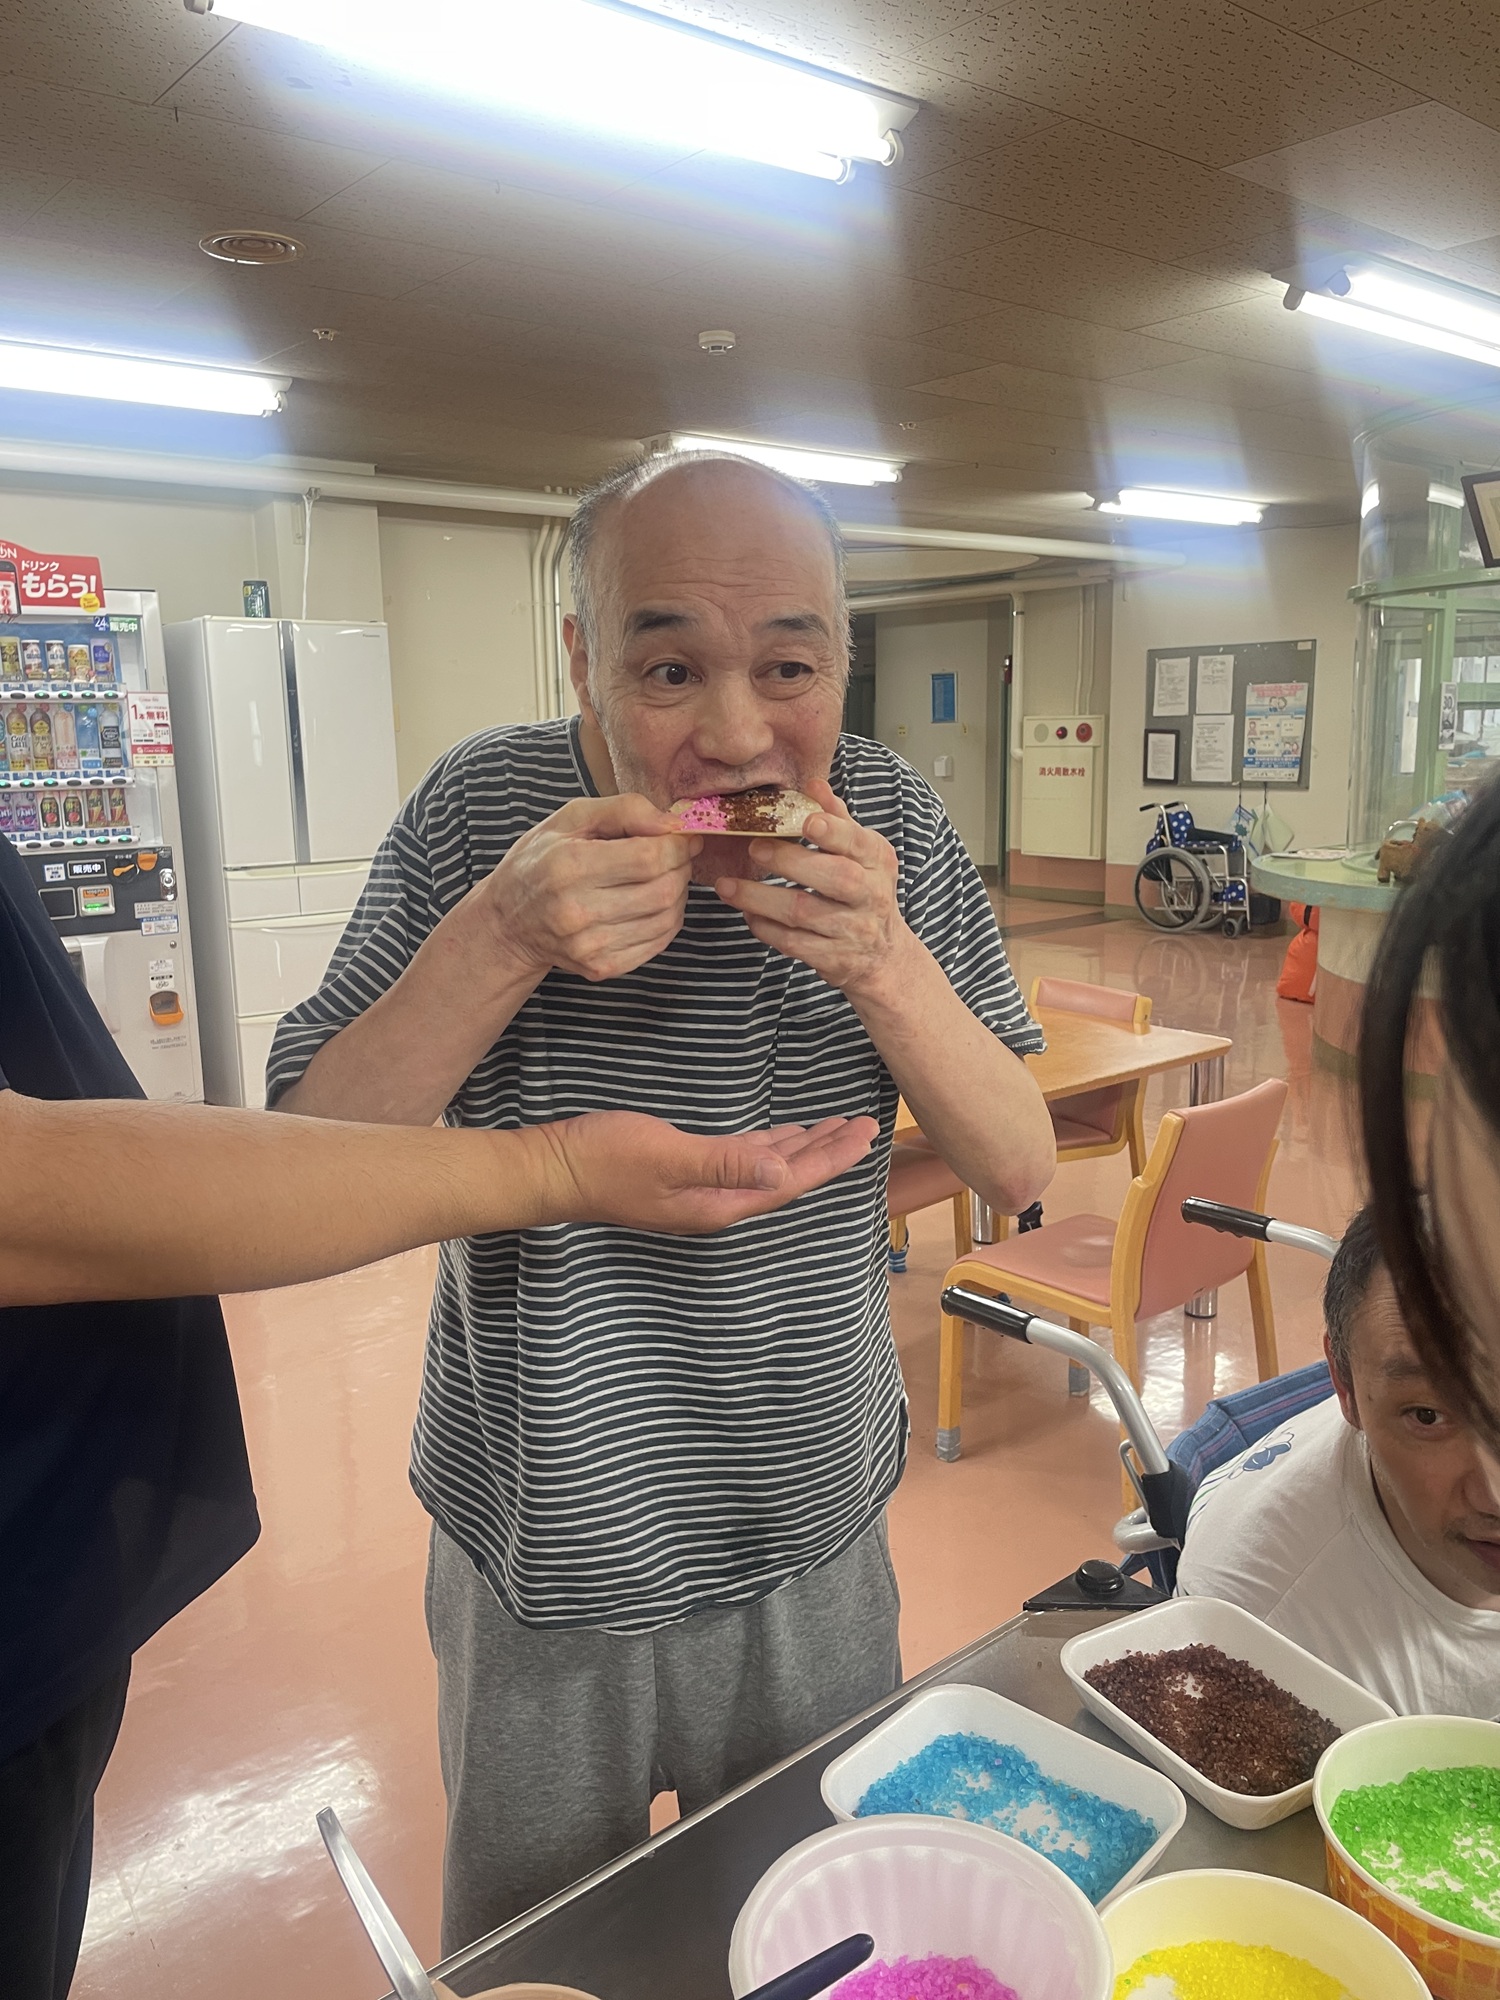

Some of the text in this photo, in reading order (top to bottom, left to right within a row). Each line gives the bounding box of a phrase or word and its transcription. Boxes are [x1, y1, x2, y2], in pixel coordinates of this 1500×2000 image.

[21, 560, 60, 572] ドリンク
[21, 572, 97, 600] もらう!
[109, 622, 138, 632] 販売中
[72, 863, 102, 875] 販売中
